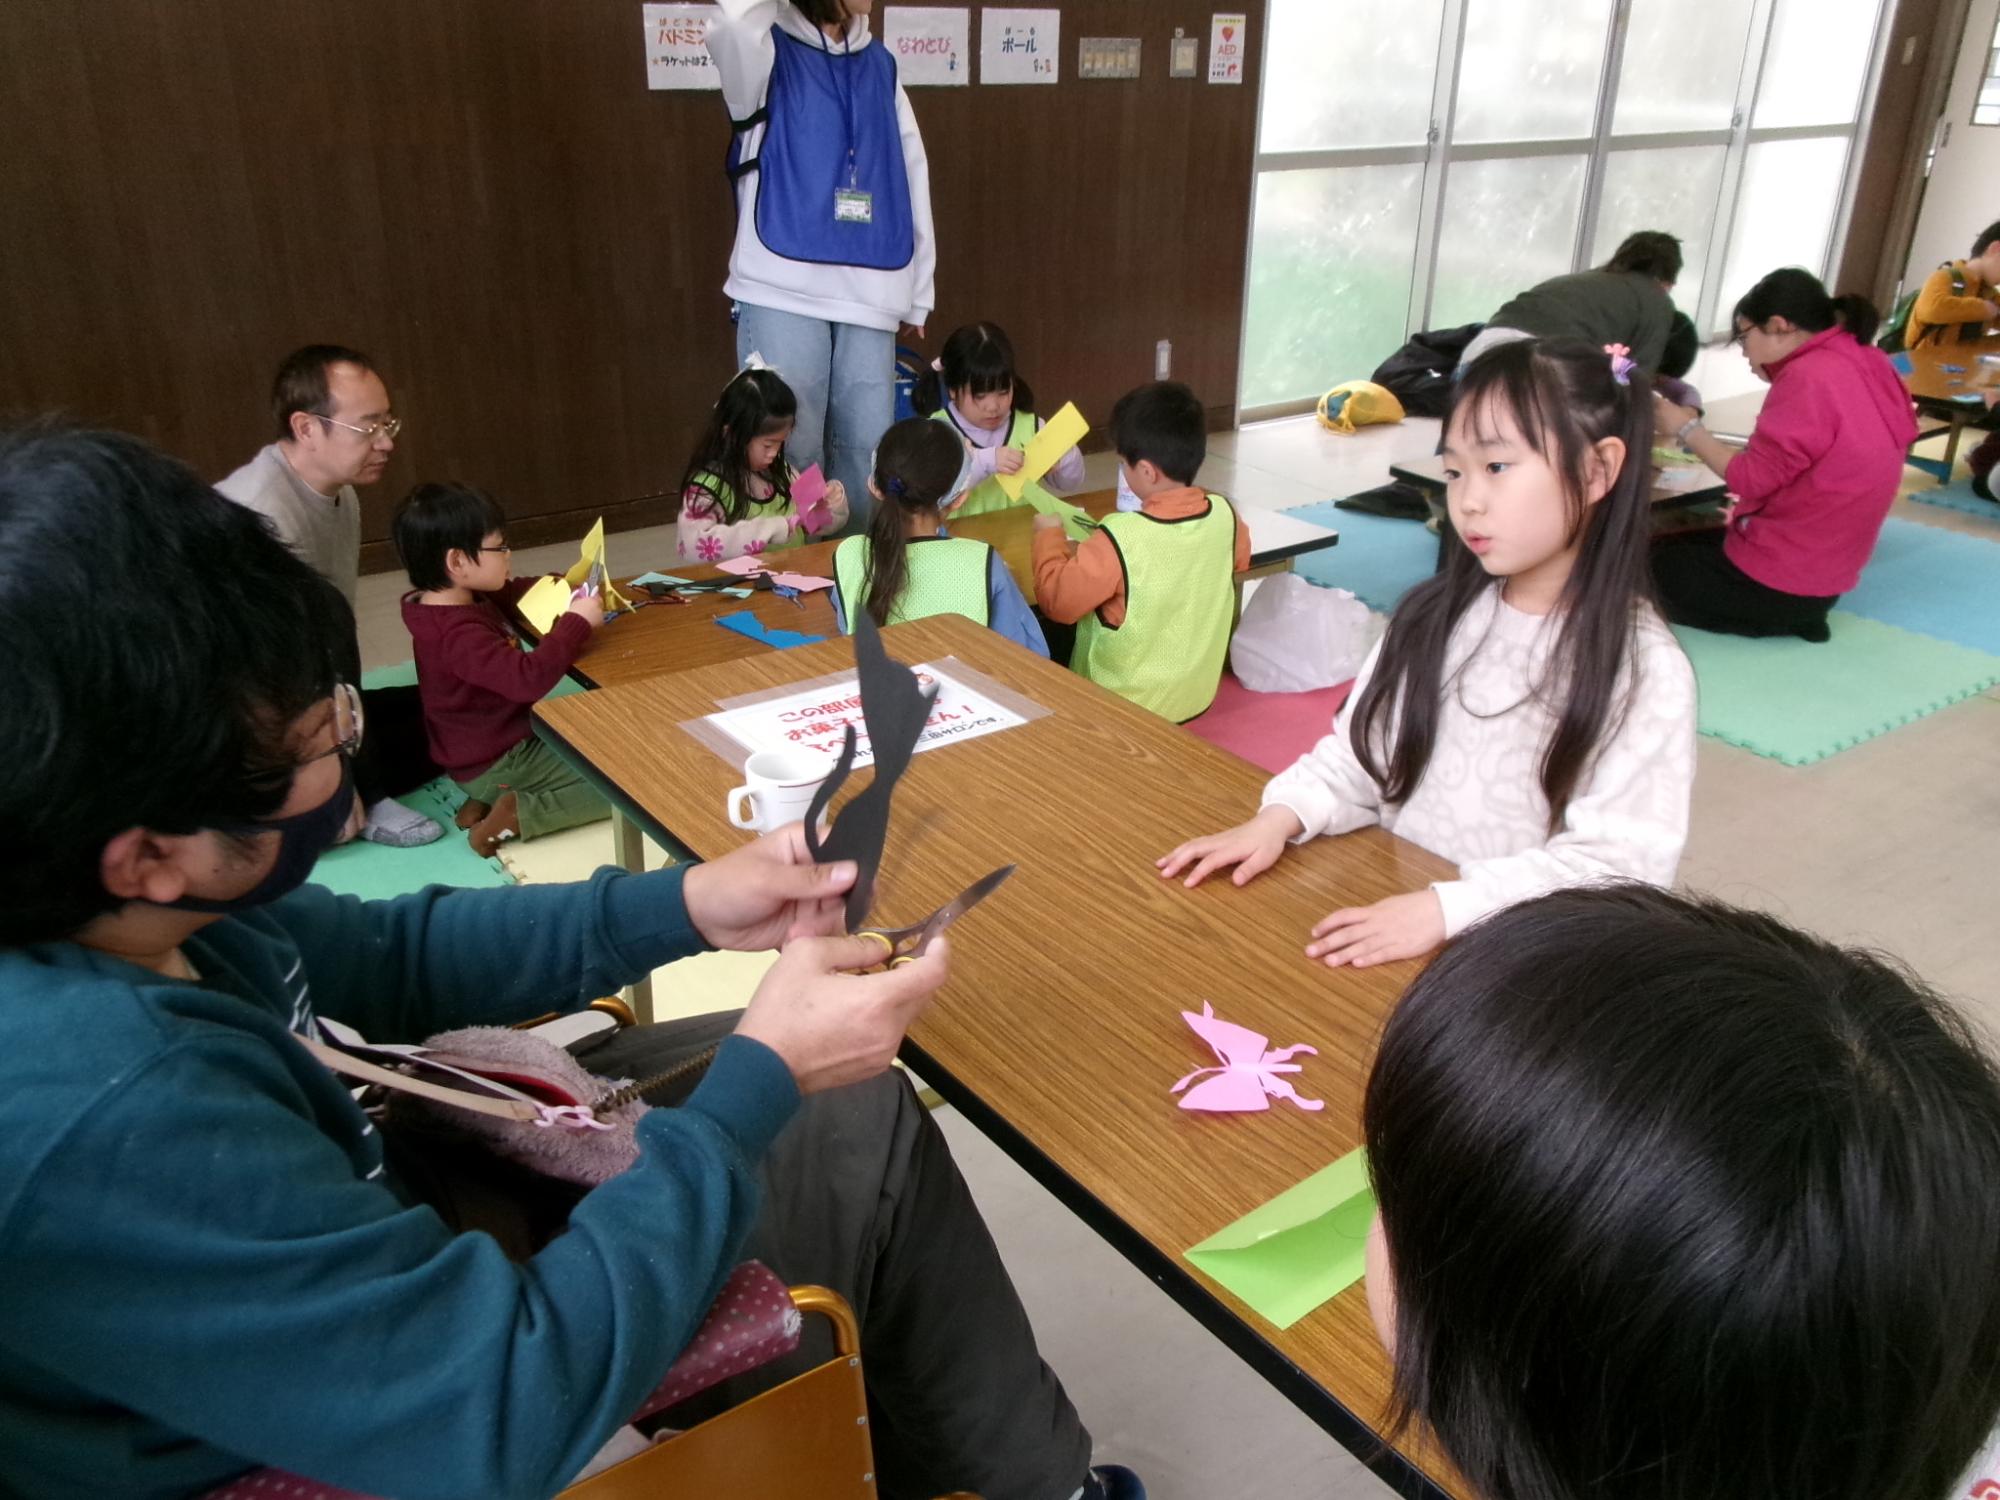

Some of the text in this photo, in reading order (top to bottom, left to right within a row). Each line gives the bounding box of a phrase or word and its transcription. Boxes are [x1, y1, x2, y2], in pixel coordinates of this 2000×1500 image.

[897, 36, 952, 54] なわとび
[1002, 37, 1038, 54] ボール
[1217, 44, 1237, 56] AED
